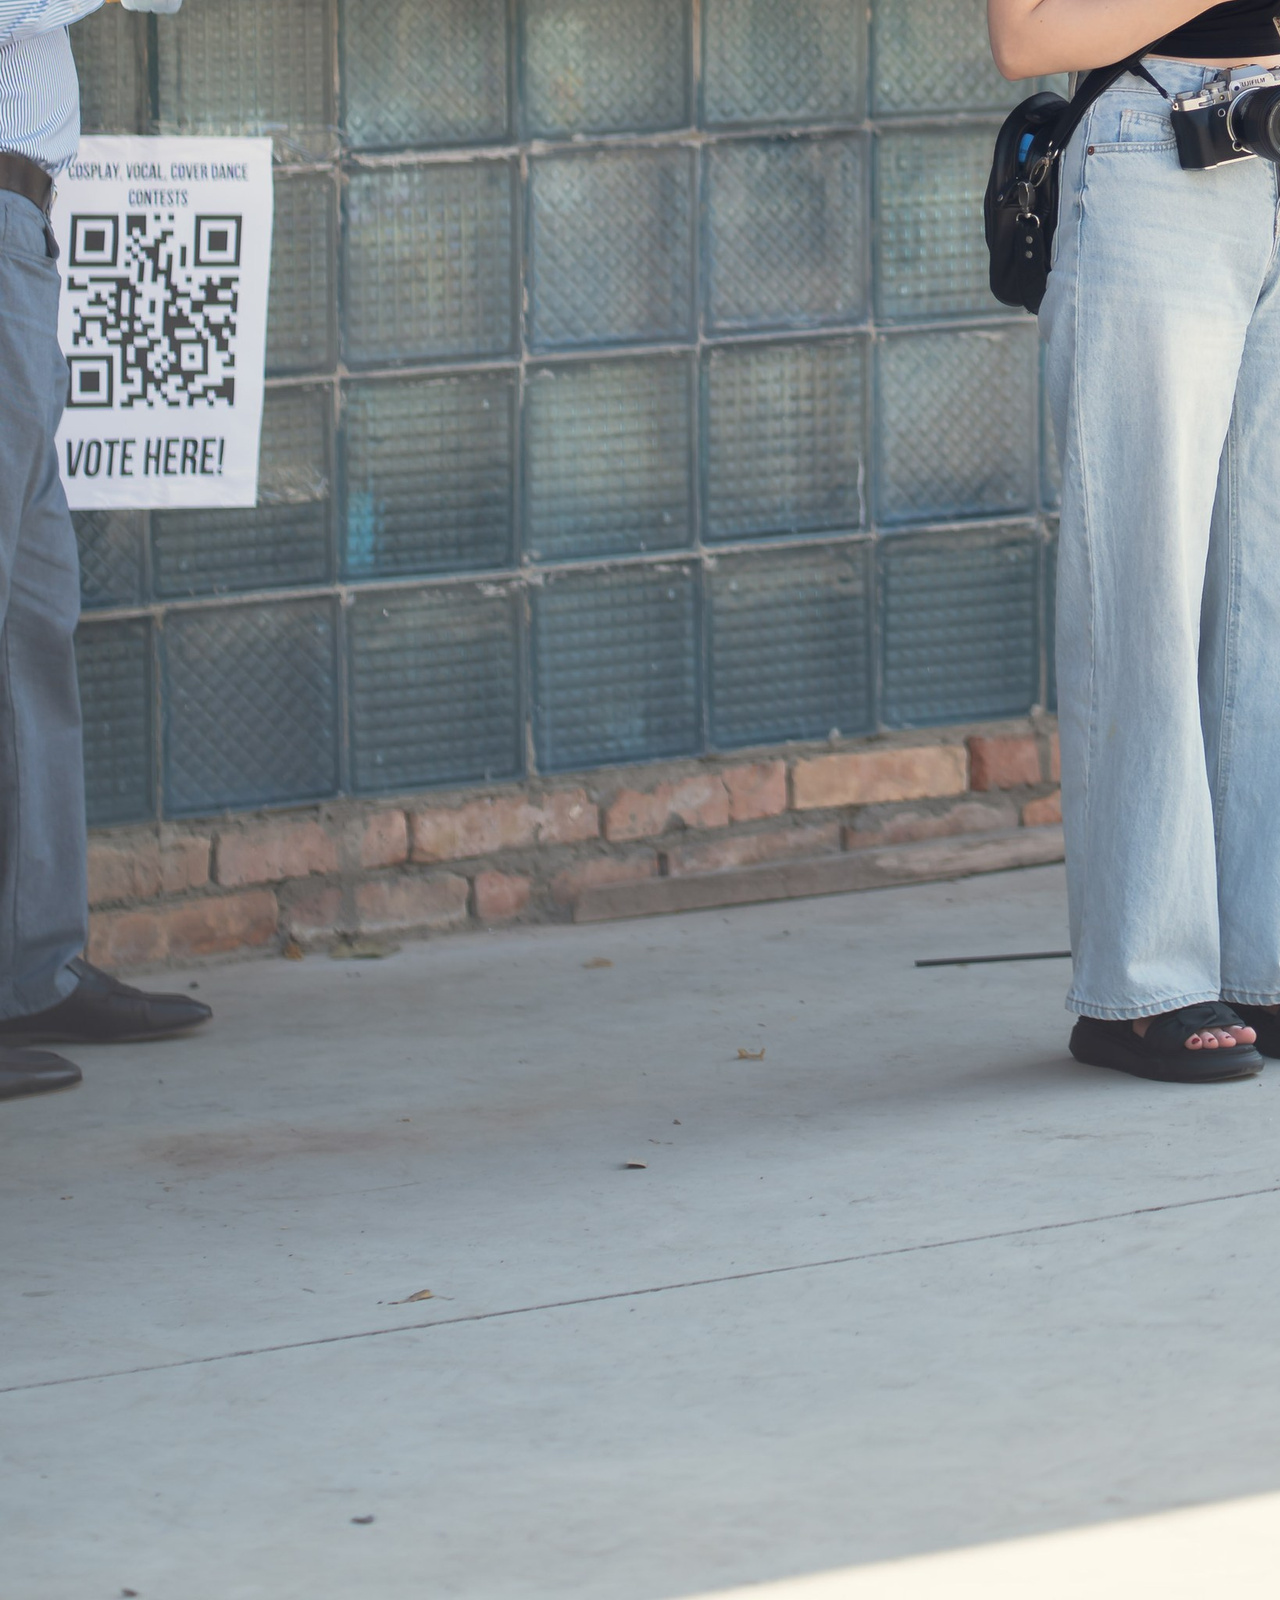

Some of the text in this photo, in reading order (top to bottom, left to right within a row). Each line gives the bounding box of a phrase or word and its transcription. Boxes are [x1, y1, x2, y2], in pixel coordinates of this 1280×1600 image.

[68, 162, 122, 182] COSPLAY,
[170, 162, 208, 181] COVER
[210, 162, 249, 181] DANCE
[128, 188, 189, 207] CONTESTS
[66, 436, 226, 477] VOTE HERE!
